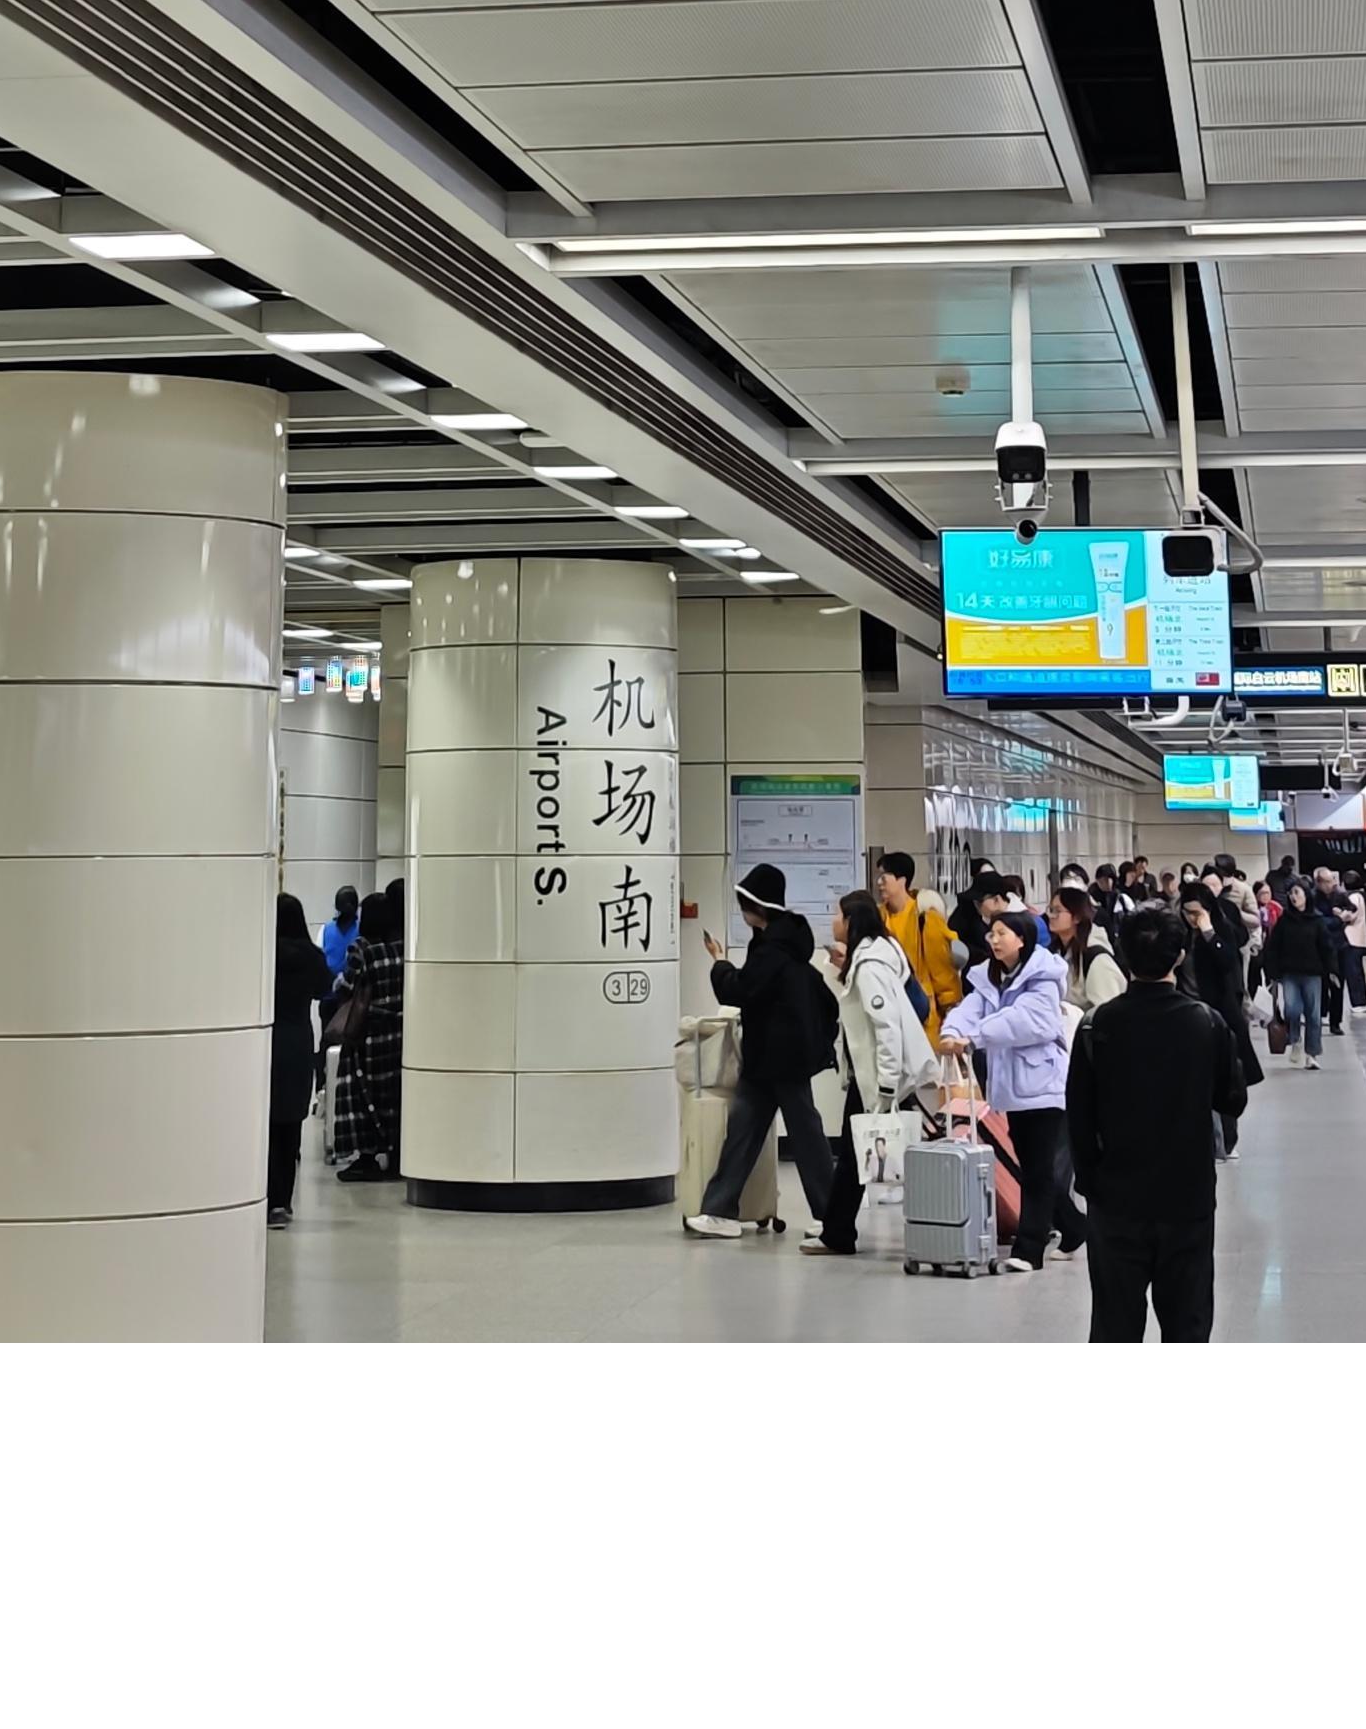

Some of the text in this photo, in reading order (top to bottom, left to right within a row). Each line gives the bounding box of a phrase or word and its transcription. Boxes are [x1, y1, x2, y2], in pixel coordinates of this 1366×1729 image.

[530, 706, 568, 906] Airport S.
[592, 659, 656, 953] 机场南
[611, 978, 648, 996] 3 29
